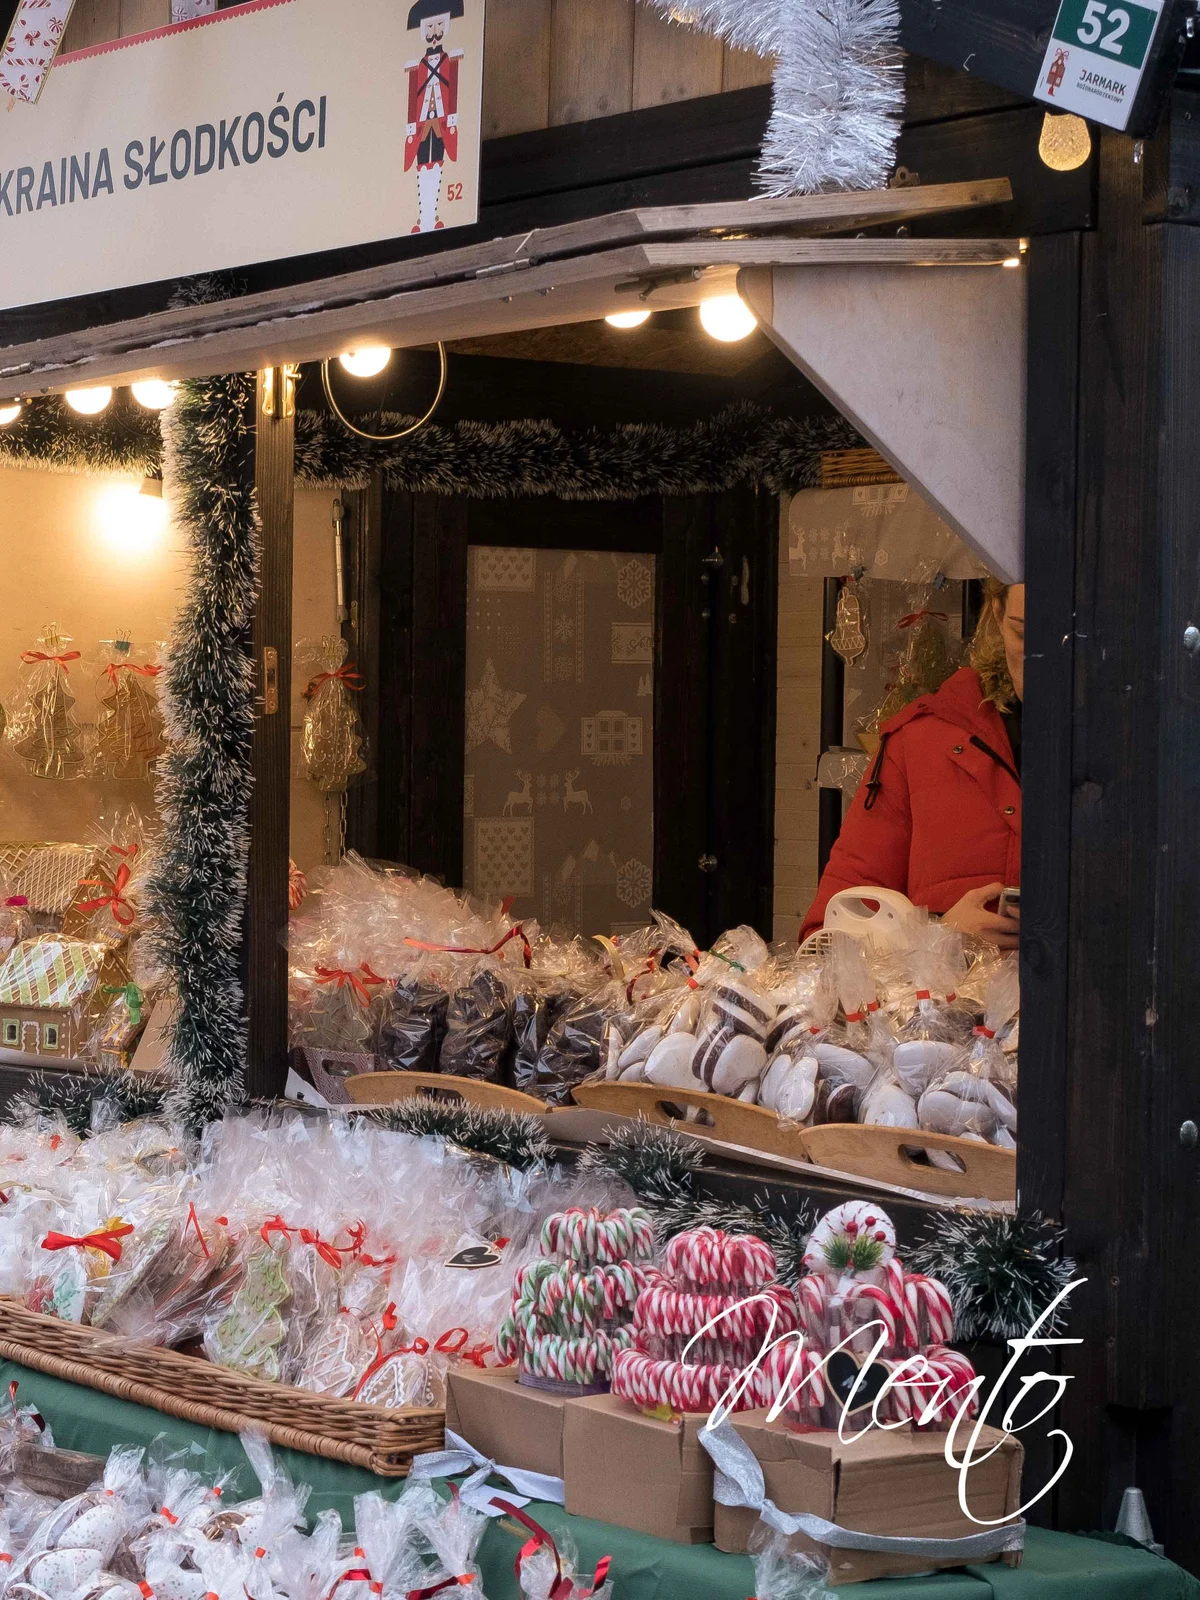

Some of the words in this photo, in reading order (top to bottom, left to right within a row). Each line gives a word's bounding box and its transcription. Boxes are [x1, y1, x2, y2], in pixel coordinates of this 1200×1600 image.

[1076, 1, 1131, 55] 52
[1079, 69, 1127, 96] JARMARK
[123, 91, 327, 190] SŁODKOŚCI
[447, 182, 463, 201] 52
